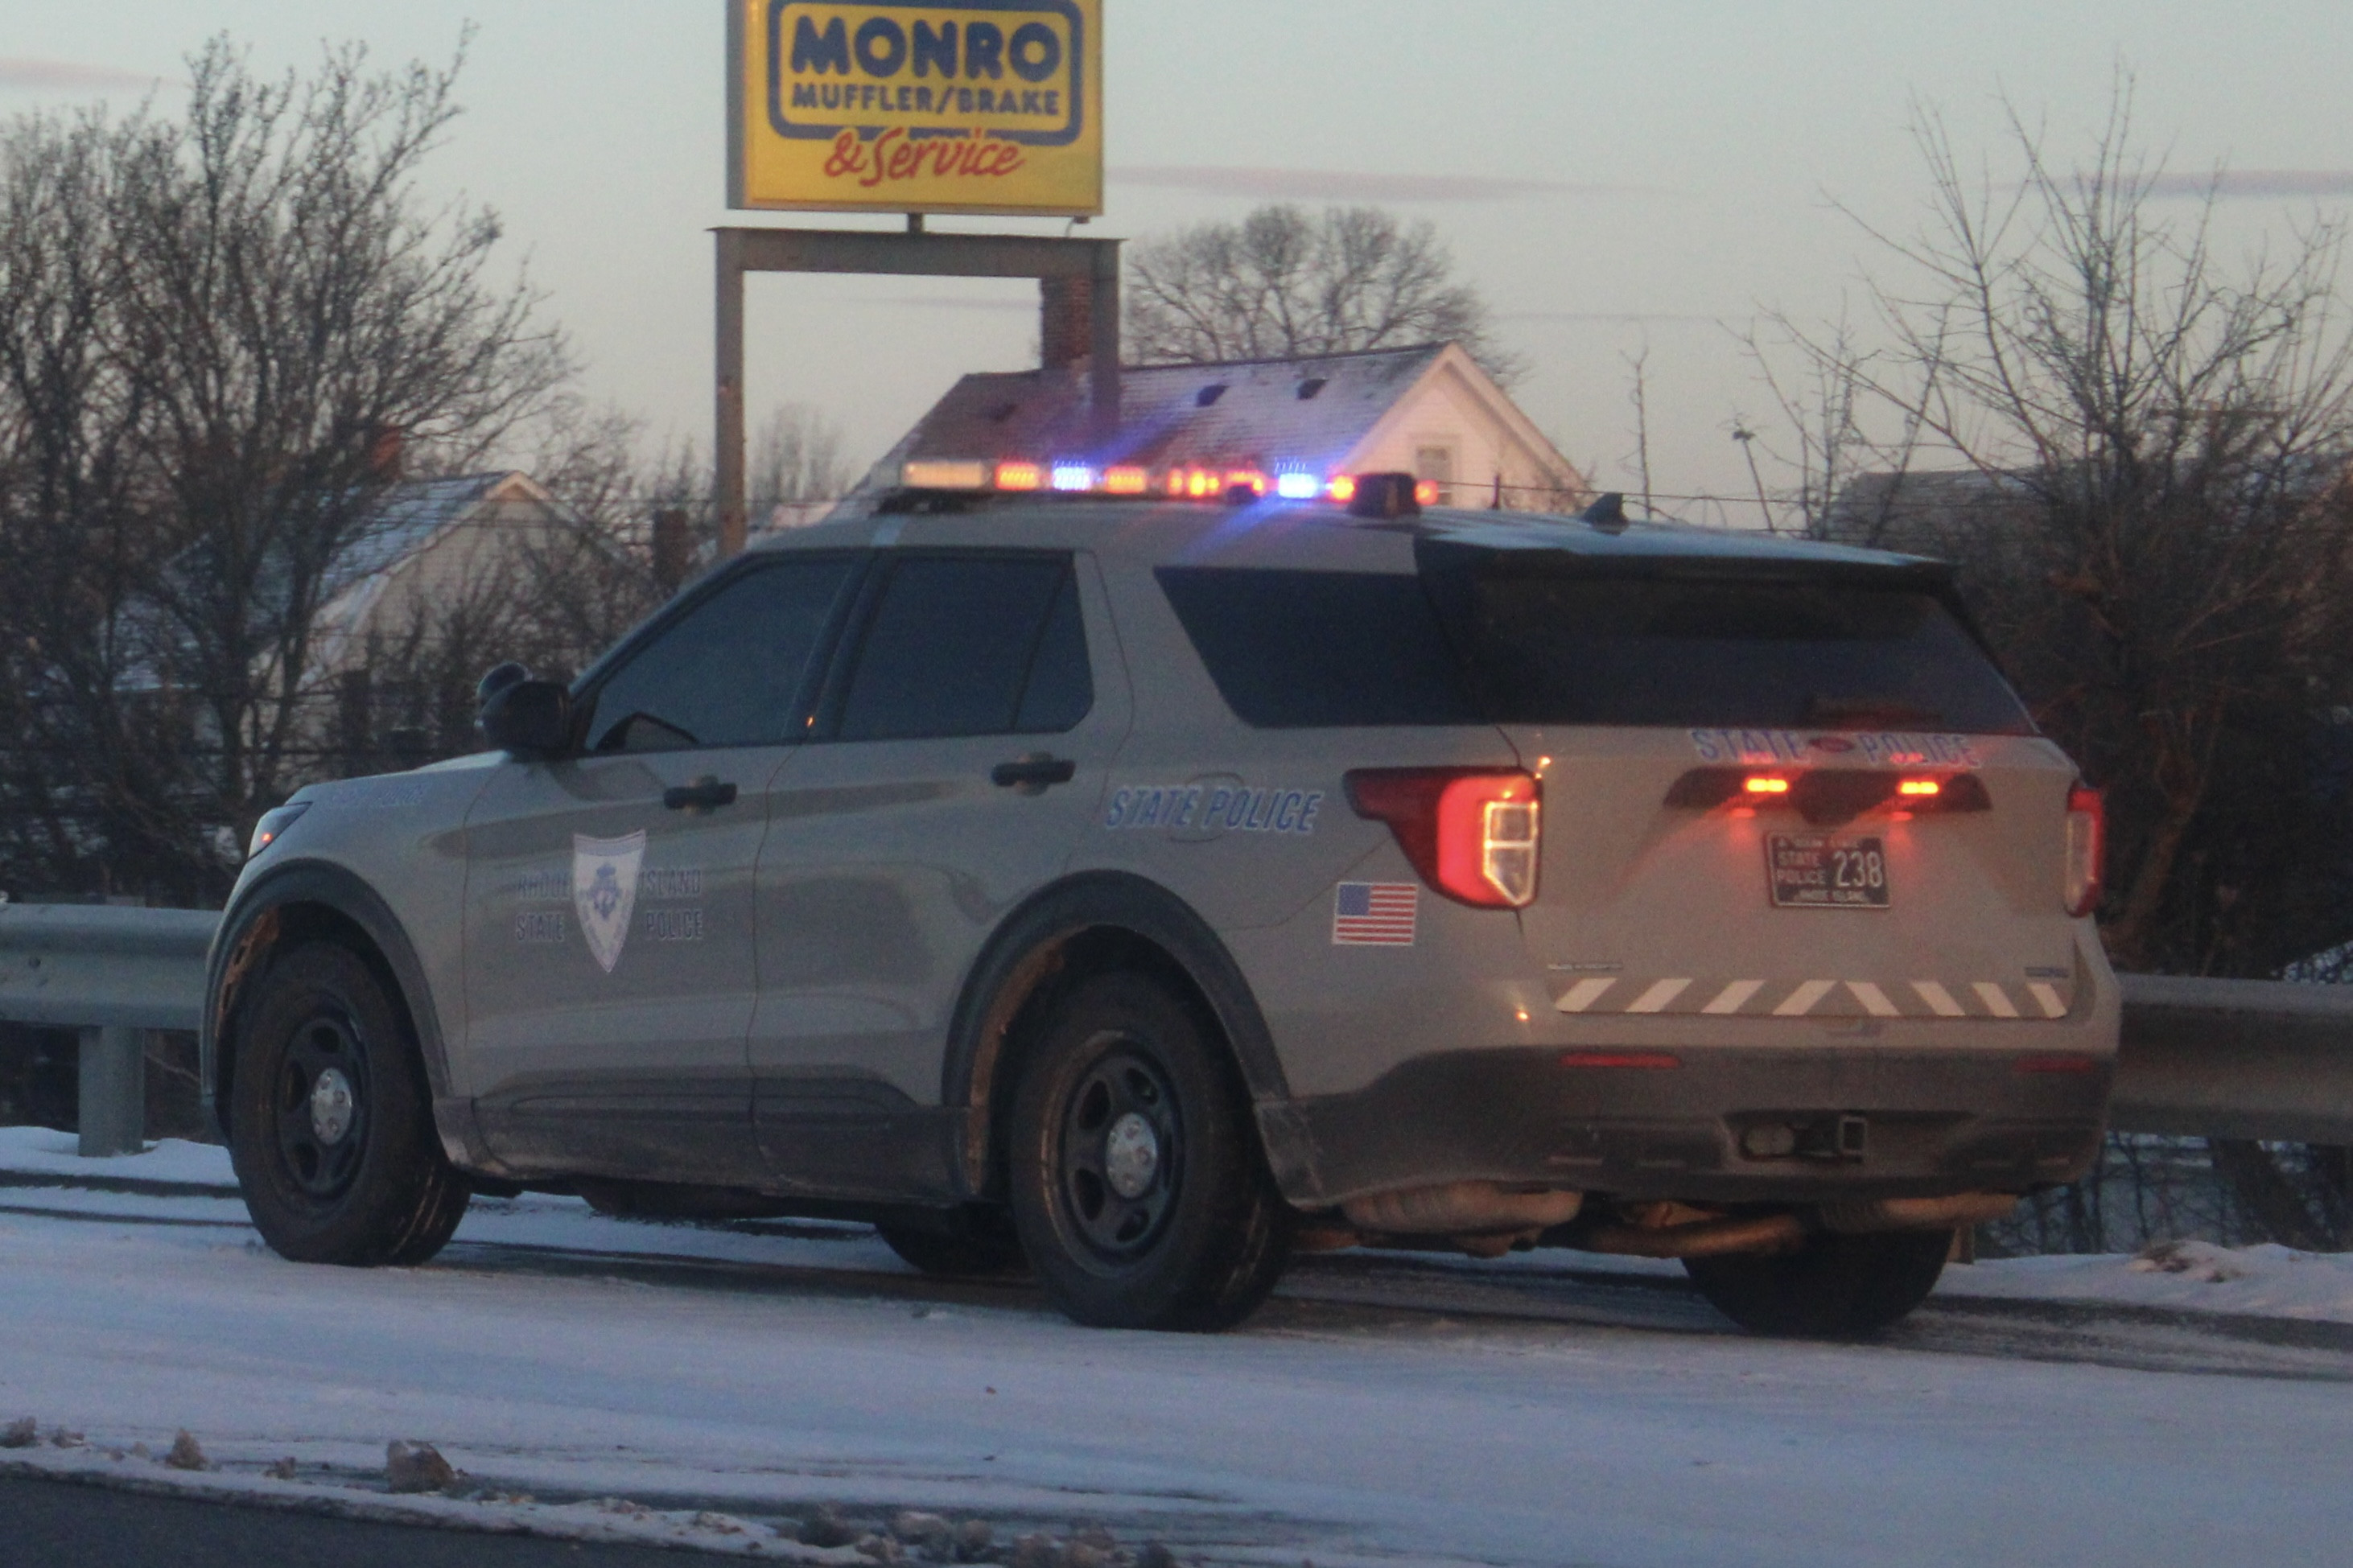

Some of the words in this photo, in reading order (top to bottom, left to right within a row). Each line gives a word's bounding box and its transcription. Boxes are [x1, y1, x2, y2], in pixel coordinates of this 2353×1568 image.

[791, 14, 1061, 82] MONRO
[792, 82, 1060, 115] MUFFLER/BRAKE
[1691, 728, 1812, 764] STATE
[1856, 731, 1983, 768] POLICE
[1106, 784, 1200, 830] STATE
[1203, 785, 1324, 834] POLICE
[1777, 850, 1820, 866] STATE
[1832, 850, 1884, 887] 238
[638, 869, 702, 897] ISLAND
[1776, 868, 1826, 884] POLICE
[516, 912, 565, 941] STATE
[645, 909, 703, 940] POLICE
